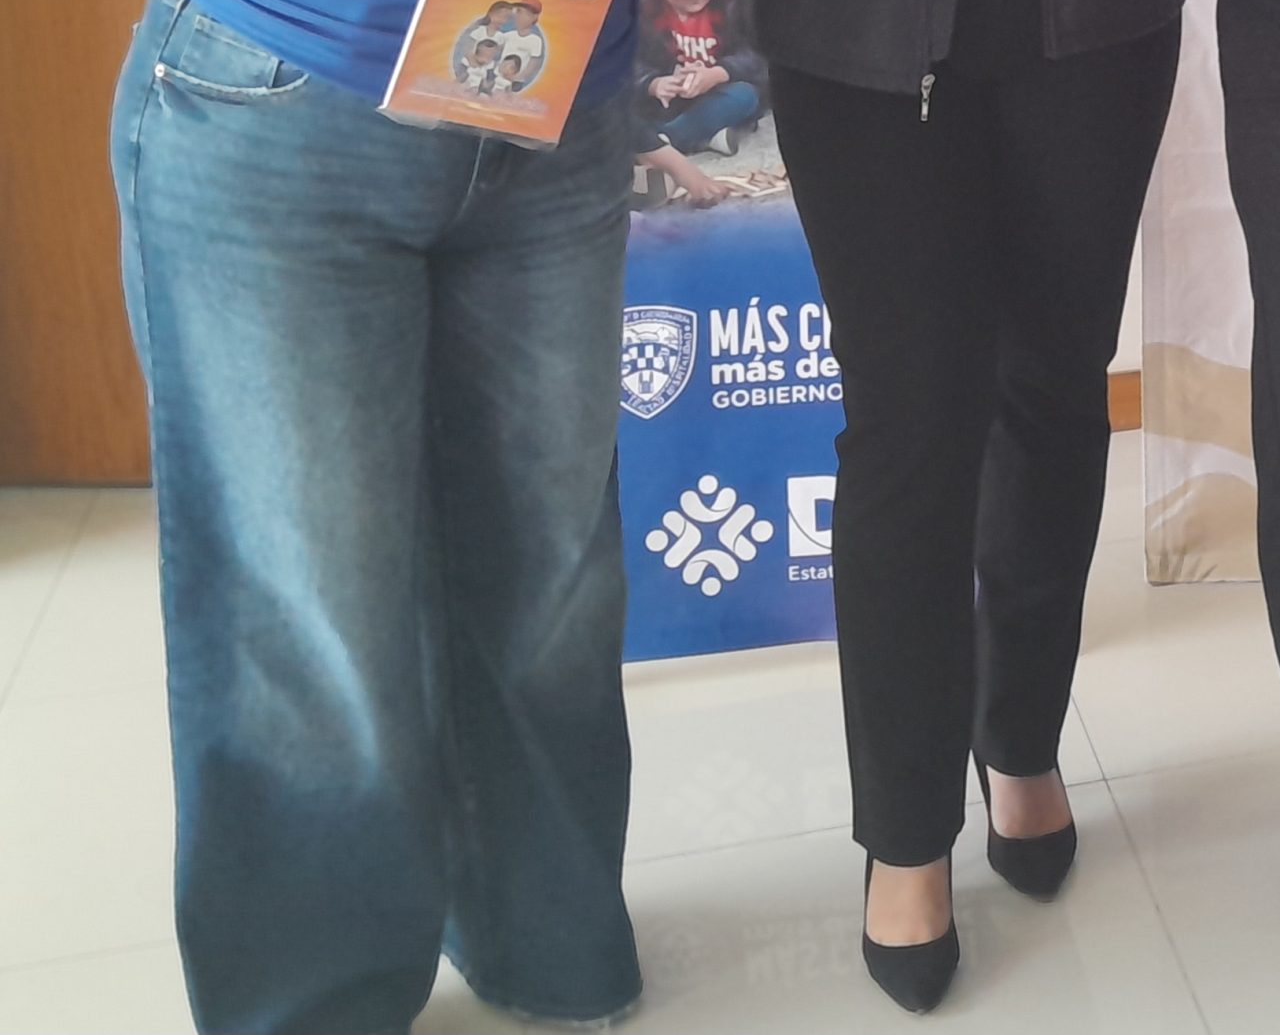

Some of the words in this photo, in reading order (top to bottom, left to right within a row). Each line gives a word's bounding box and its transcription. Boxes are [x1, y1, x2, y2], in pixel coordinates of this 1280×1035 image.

[710, 296, 790, 357] MÁS
[711, 354, 786, 385] más
[796, 351, 841, 380] de
[712, 382, 843, 409] GOBIERNO
[788, 564, 834, 582] Estat
